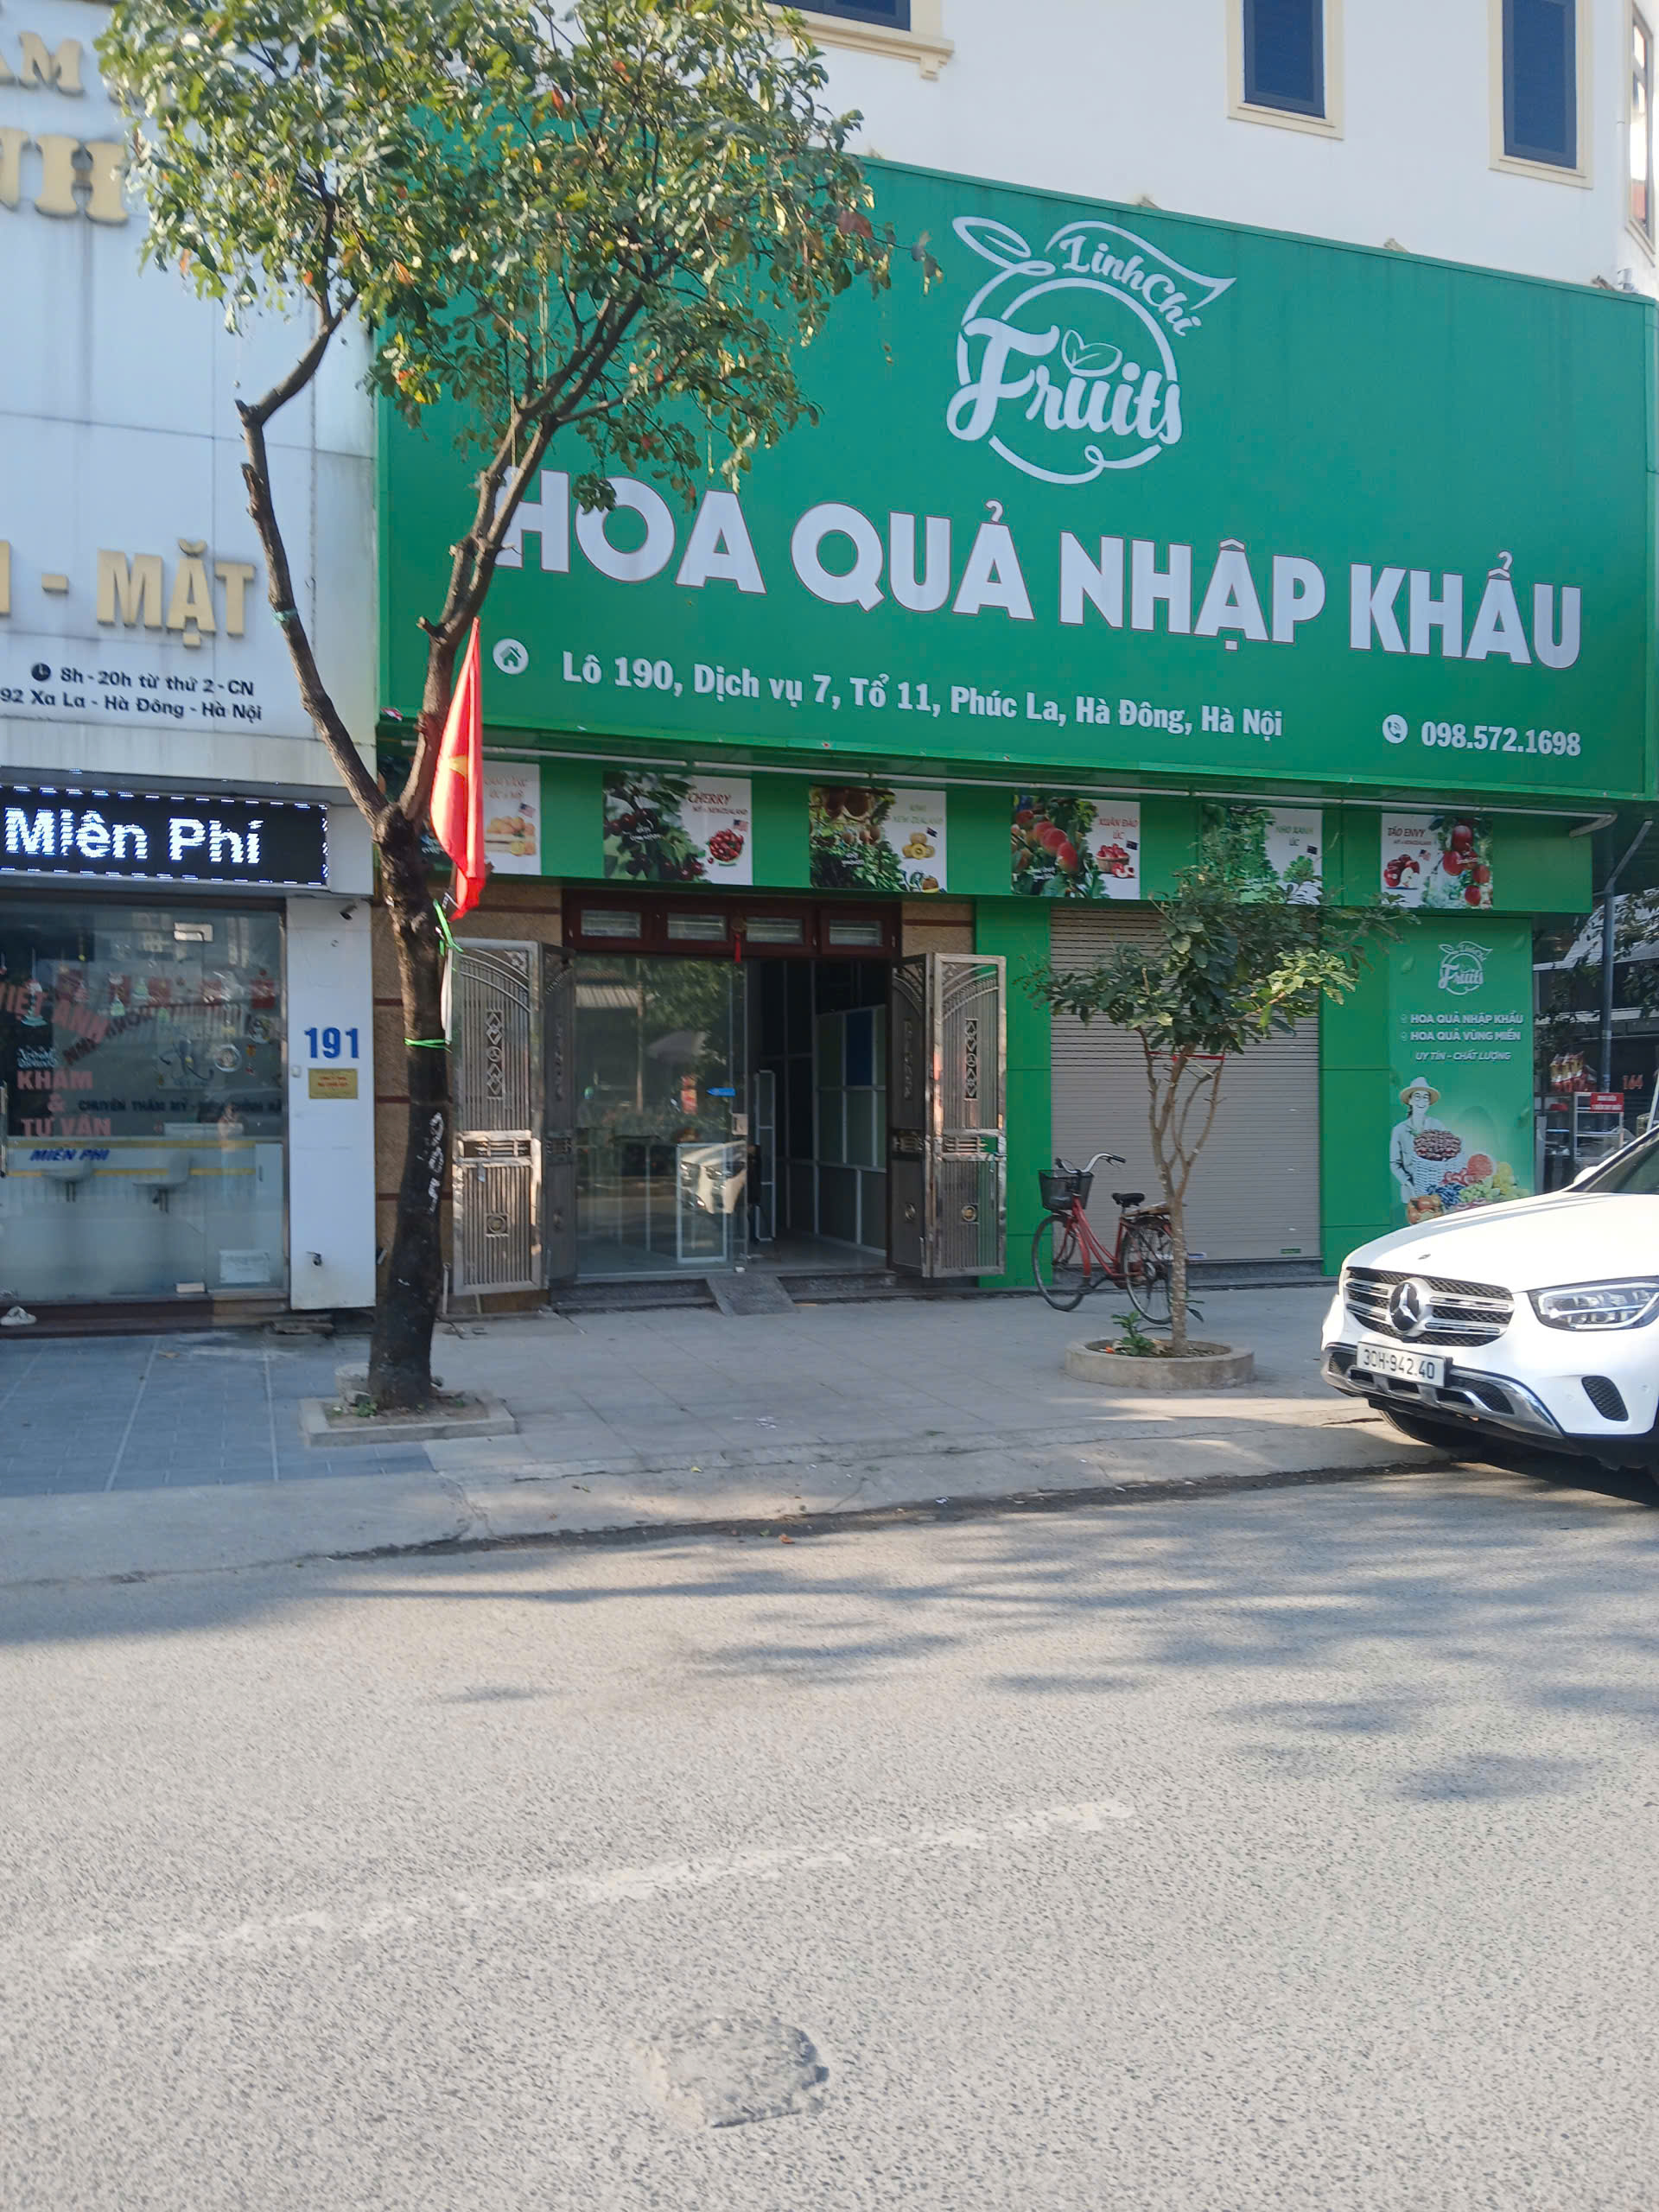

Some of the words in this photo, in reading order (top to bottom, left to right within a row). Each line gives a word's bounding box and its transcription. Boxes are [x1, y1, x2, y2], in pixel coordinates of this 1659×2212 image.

[0, 32, 84, 96] M
[946, 316, 1183, 445] Fruits
[493, 465, 767, 594] HOA
[790, 499, 1036, 621] QUẢ
[1059, 531, 1326, 652] NHẬP
[1349, 550, 1582, 670] KHẨU
[97, 538, 257, 647] MẶT
[138, 672, 160, 690] từ
[563, 651, 602, 685] Lô
[614, 657, 683, 697] 190,
[694, 664, 760, 702] Dịch
[768, 677, 803, 708] vụ
[812, 674, 841, 710] 7,
[849, 673, 890, 708] Tổ
[898, 682, 941, 718] 11,
[950, 685, 1017, 718] Phúc
[1027, 692, 1066, 727] La,
[1076, 696, 1110, 725] Hà
[1118, 701, 1192, 735] Đông,
[1201, 705, 1235, 734] Hà
[1243, 709, 1282, 741] Nội
[30, 689, 56, 706] Xa
[62, 691, 86, 709] La
[105, 694, 130, 712] Hà
[136, 696, 184, 719] Đông
[201, 700, 226, 718] Hà
[232, 702, 262, 724] Nội
[1421, 721, 1581, 757] 098.572.1698
[688, 792, 732, 806] CHERRY
[168, 817, 264, 865] Phí
[1410, 1014, 1435, 1024] HOA
[1437, 1011, 1461, 1024] QUẢ
[1463, 1013, 1493, 1027] NHẬP
[1410, 1031, 1435, 1041] HOA
[1437, 1028, 1461, 1041] QUẢ
[304, 1027, 359, 1059] 191
